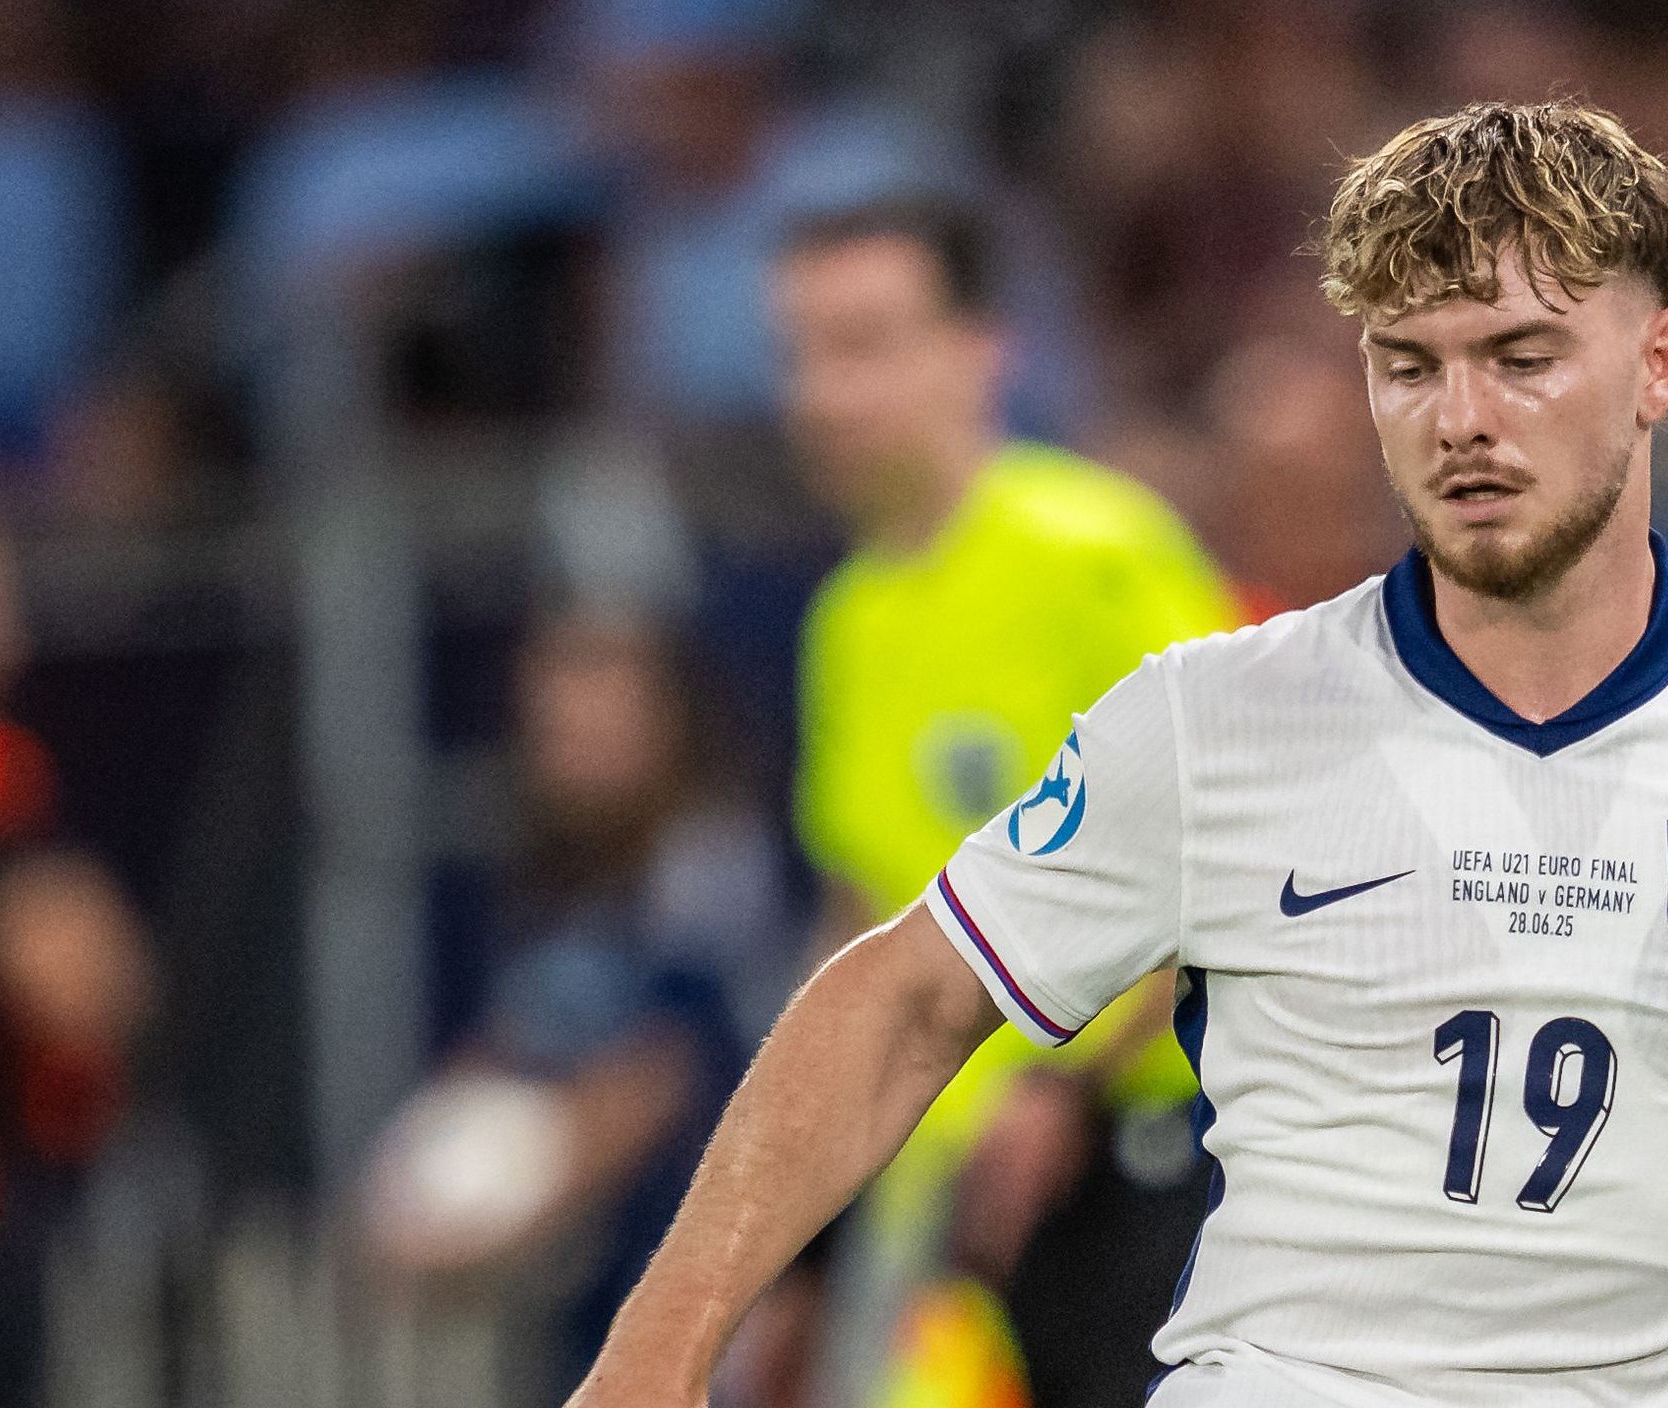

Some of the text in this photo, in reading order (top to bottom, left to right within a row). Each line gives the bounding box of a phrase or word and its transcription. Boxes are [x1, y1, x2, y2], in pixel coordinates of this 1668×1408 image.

[1452, 850, 1638, 884] UEFA U21 EURO FINAL
[1452, 879, 1635, 914] ENGLAND v GERMANY
[1508, 911, 1574, 937] 28.06.25
[1433, 1009, 1618, 1214] 19
